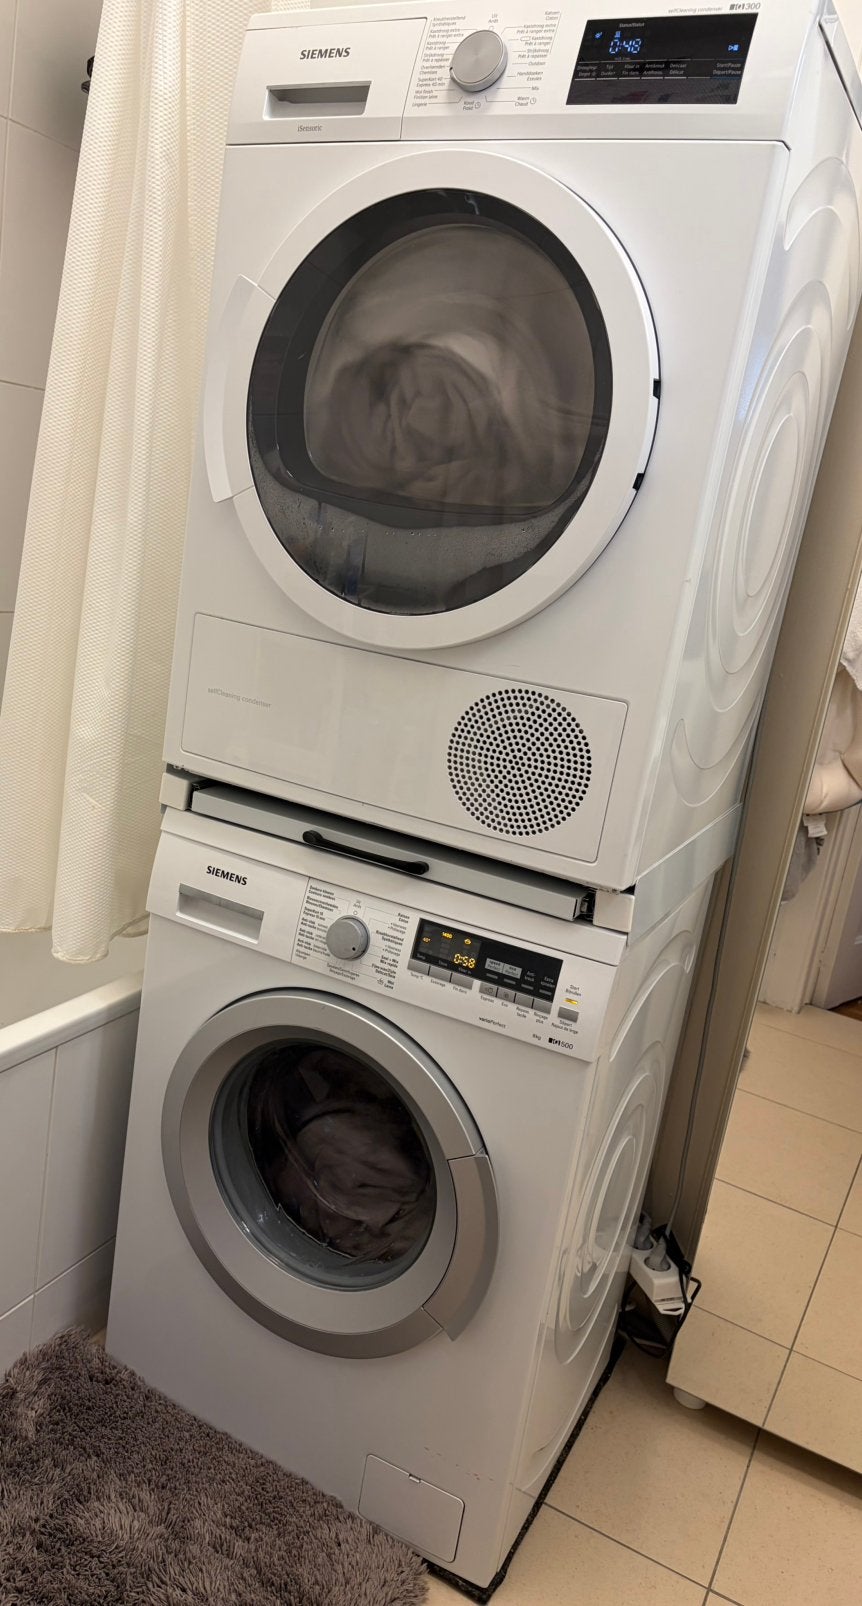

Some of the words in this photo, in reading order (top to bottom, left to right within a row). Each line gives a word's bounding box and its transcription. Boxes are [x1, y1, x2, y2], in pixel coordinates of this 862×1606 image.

[300, 47, 350, 60] SIEMENS
[609, 38, 642, 54] 0:48
[206, 865, 248, 886] SIEMENS
[453, 953, 476, 969] 0:58
